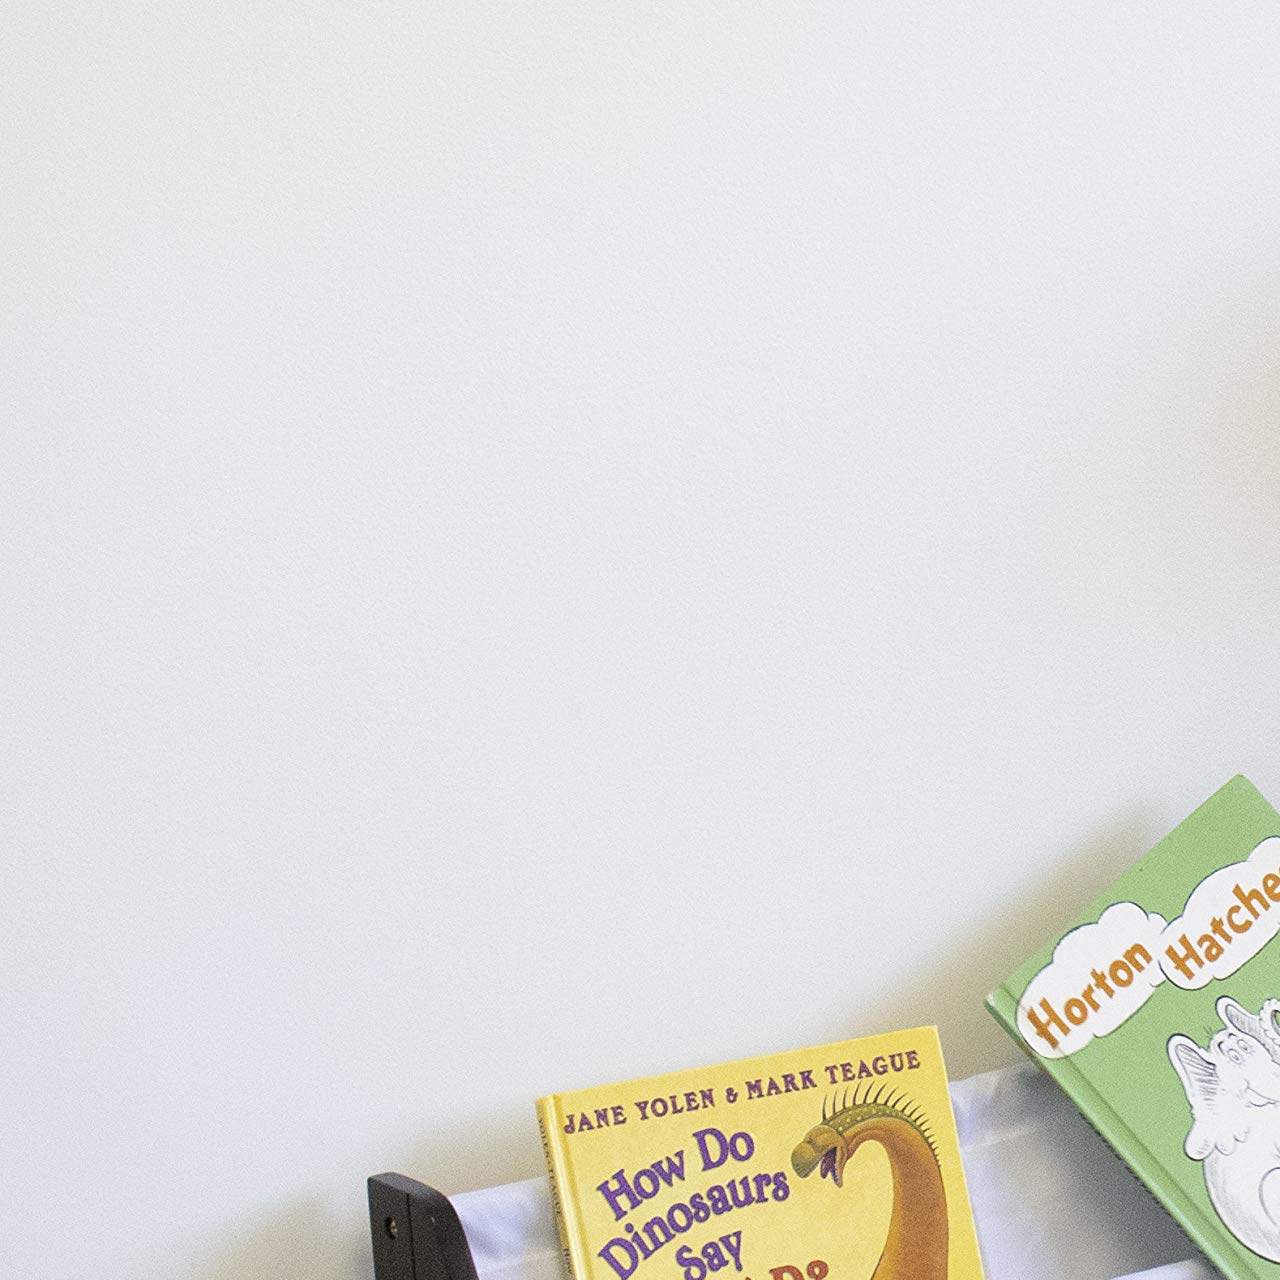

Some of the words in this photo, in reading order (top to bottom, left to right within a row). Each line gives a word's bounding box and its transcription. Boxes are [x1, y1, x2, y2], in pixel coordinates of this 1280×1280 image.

[1026, 939, 1153, 1051] Horton
[564, 1105, 627, 1134] JANE
[634, 1088, 715, 1121] YOLEN
[725, 1087, 738, 1104] &
[745, 1069, 818, 1100] MARK
[824, 1050, 921, 1084] TEAGUE
[596, 1150, 688, 1221] How
[692, 1127, 755, 1170] Do
